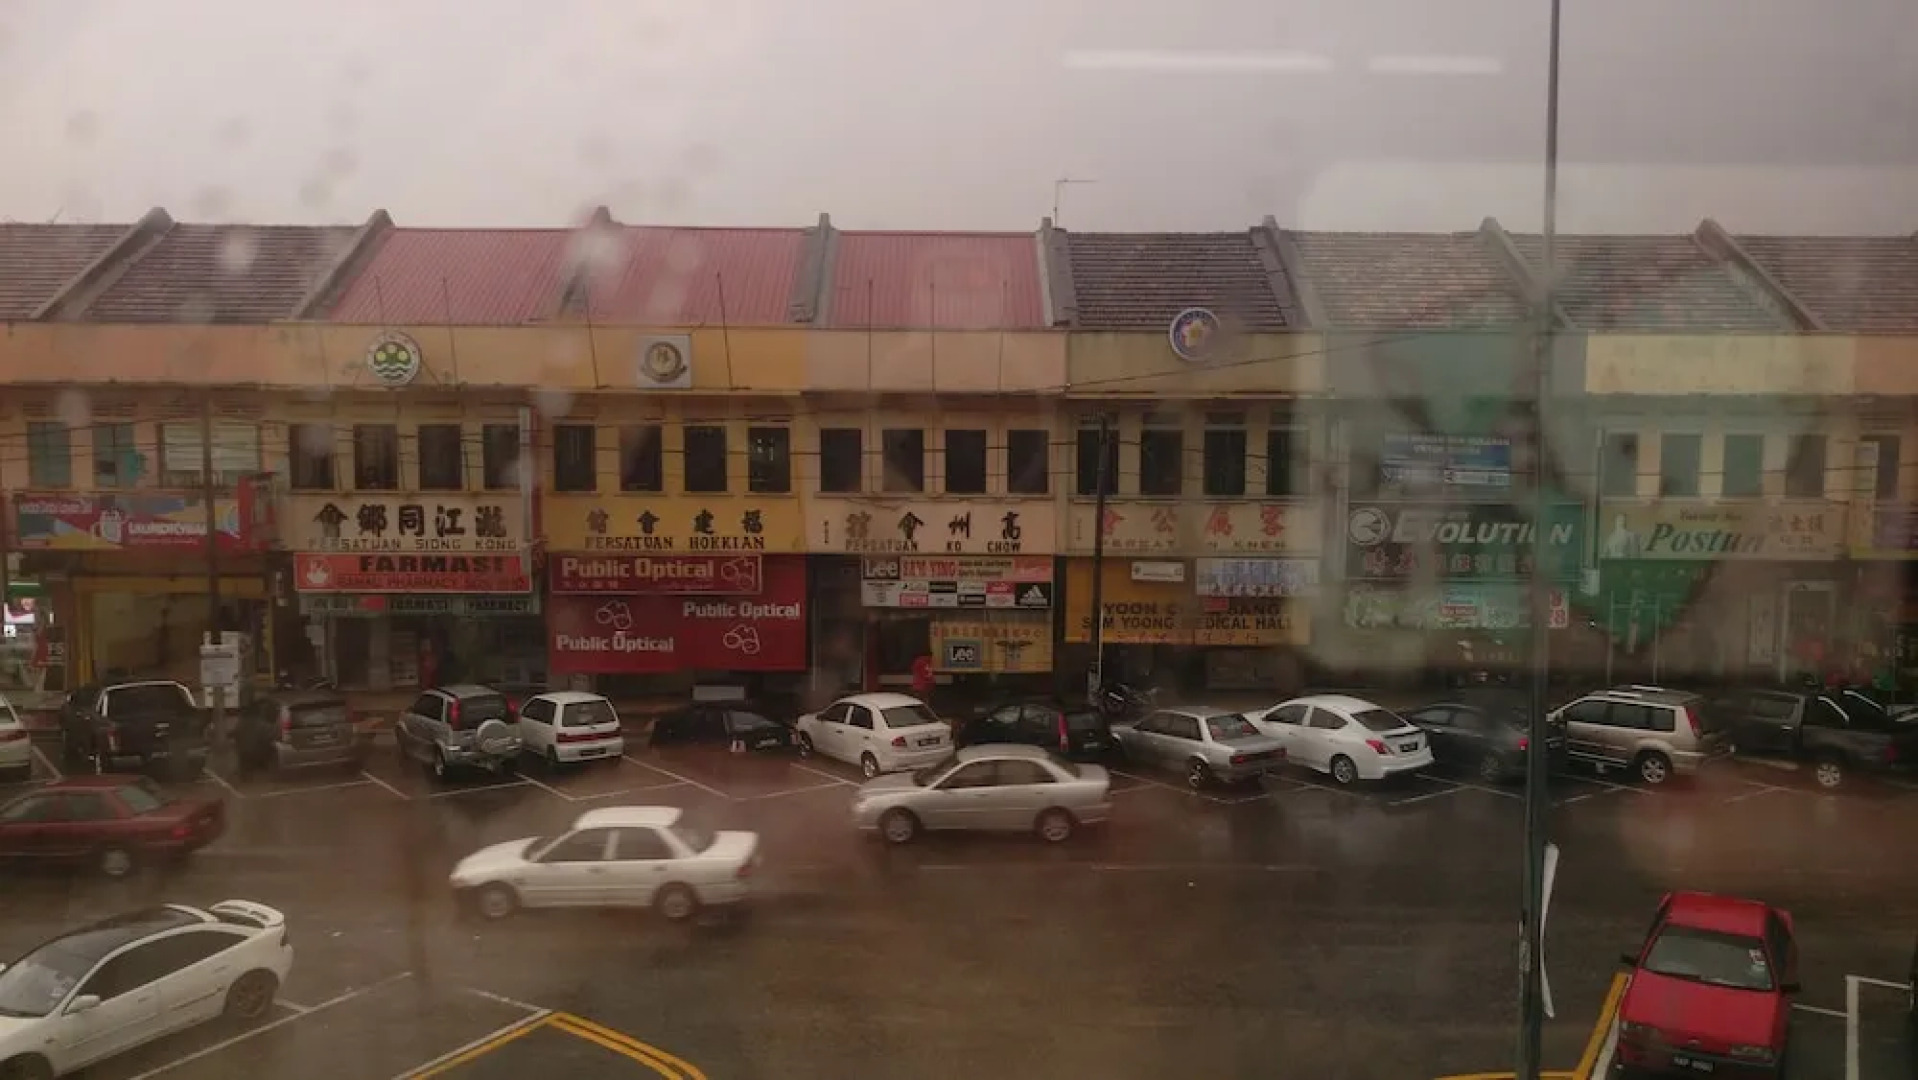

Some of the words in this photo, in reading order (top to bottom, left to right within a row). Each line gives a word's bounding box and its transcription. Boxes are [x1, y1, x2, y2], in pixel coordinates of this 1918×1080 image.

[308, 539, 400, 550] PERSATUAN
[415, 539, 461, 550] SIONG
[476, 539, 518, 550] KONG
[585, 537, 673, 549] PERSATUAN
[690, 537, 764, 549] HOKKIAN
[845, 540, 918, 552] PERSATUAN
[946, 541, 962, 552] KO
[987, 541, 1021, 552] CHOW
[359, 556, 504, 572] FARMASI
[562, 557, 630, 578] Public
[635, 557, 714, 582] Optical
[865, 558, 899, 578] Lee
[683, 601, 737, 617] Public
[740, 601, 800, 620] Optical
[1103, 603, 1158, 614] YOON
[1082, 616, 1114, 629] SM
[1121, 616, 1174, 629] YOONG
[556, 635, 609, 651] Public
[613, 635, 674, 653] Optical
[951, 646, 975, 662] Lee
